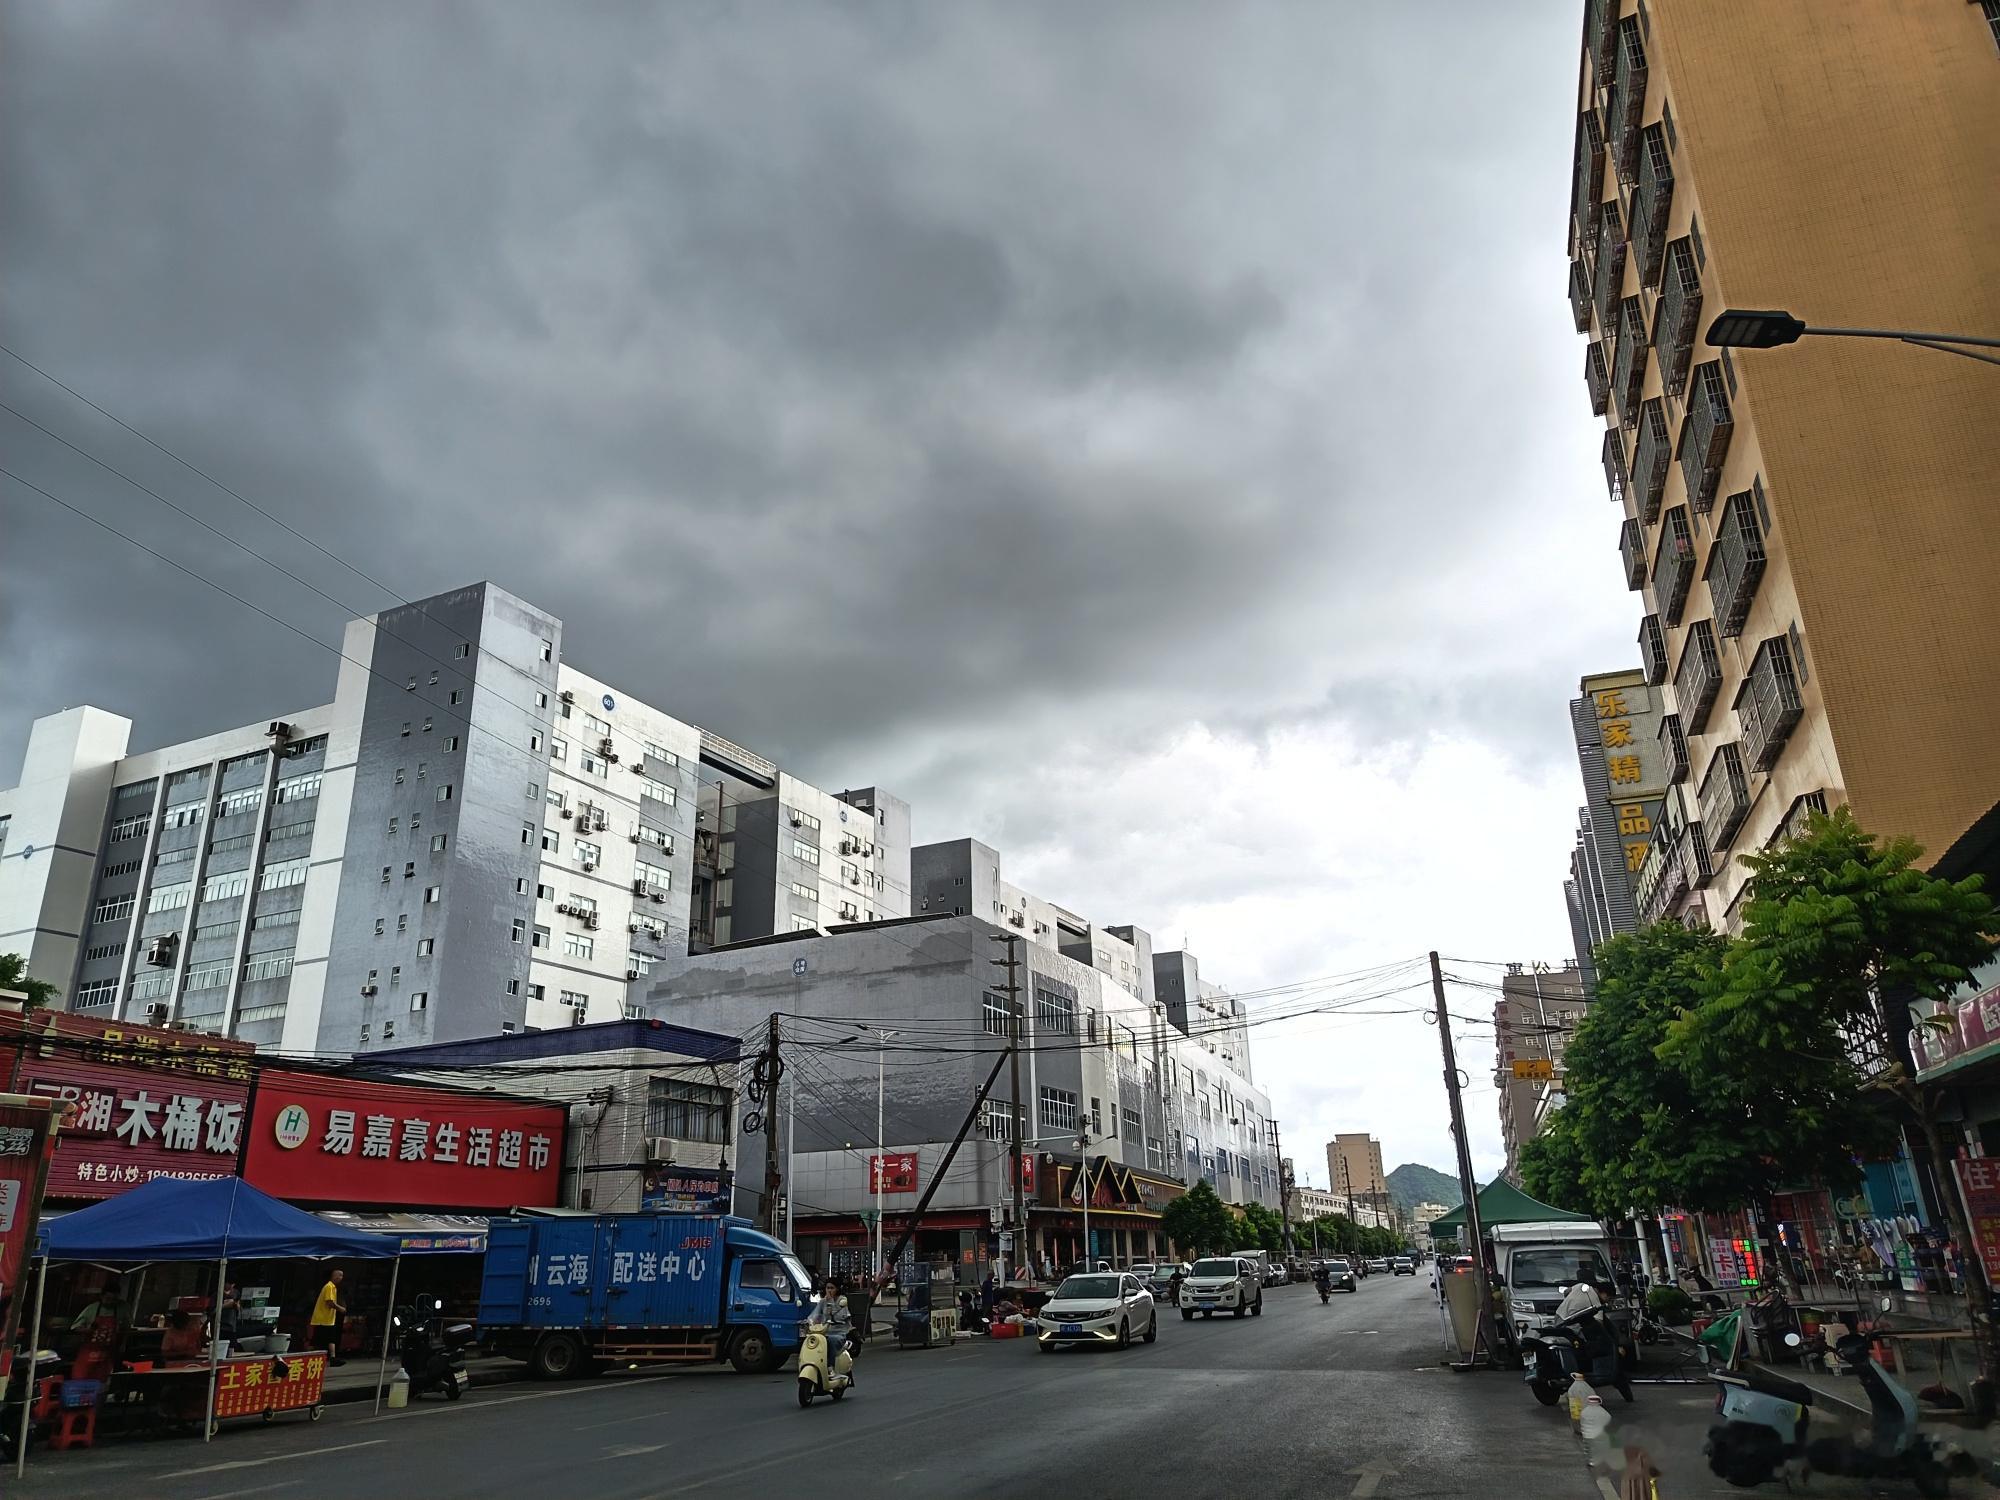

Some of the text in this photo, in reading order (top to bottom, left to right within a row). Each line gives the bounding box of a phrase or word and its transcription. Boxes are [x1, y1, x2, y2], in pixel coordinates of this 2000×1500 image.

[324, 1109, 550, 1170] 易嘉豪生活超市
[678, 1236, 712, 1250] JMC
[612, 1250, 706, 1284] 配送中心
[527, 1296, 552, 1306] 2696
